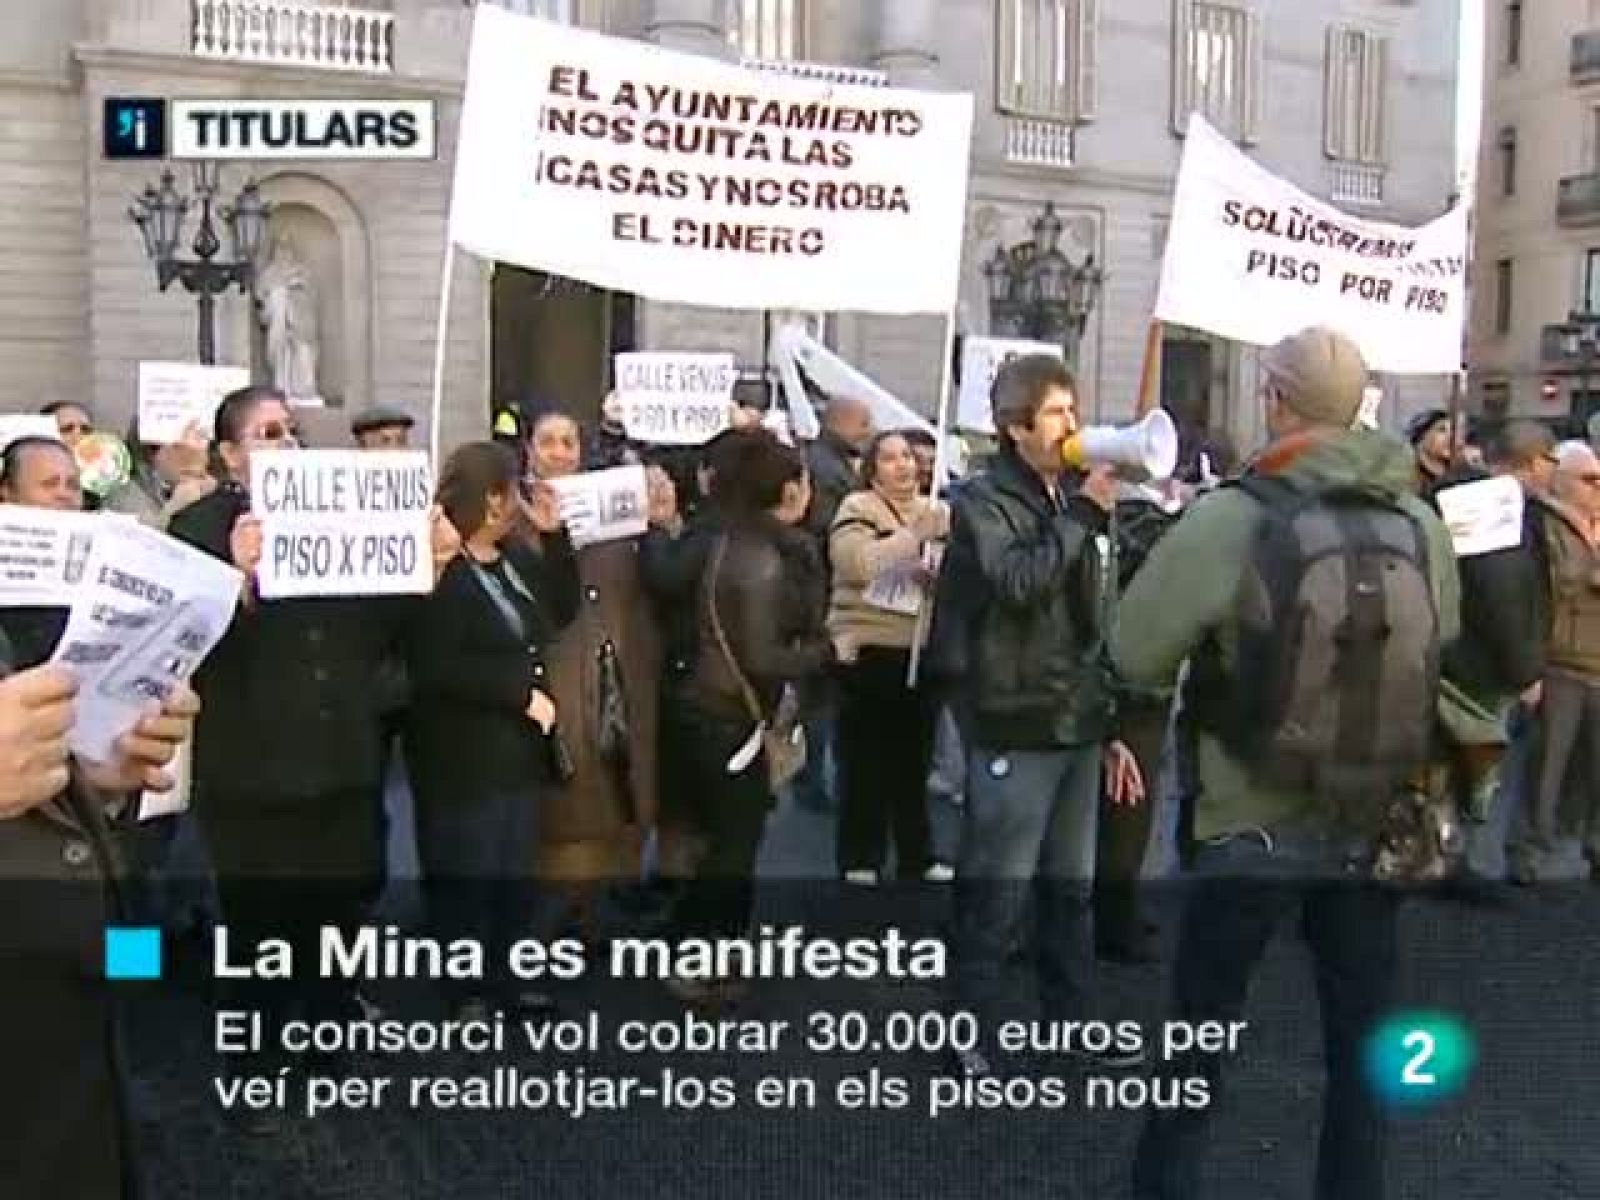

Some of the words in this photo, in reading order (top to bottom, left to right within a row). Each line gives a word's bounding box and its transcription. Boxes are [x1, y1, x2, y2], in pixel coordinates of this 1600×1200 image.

[548, 65, 600, 101] EL
[611, 80, 924, 137] AYUNTAMIENTO
[547, 107, 636, 145] NOS
[643, 119, 771, 162] QUITA
[781, 136, 853, 169] LAS
[547, 154, 689, 199] CASAS
[697, 172, 720, 201] Y
[725, 175, 811, 208] NOS
[814, 180, 911, 214] ROBA
[612, 212, 664, 244] EL
[672, 217, 825, 257] DINERO
[1247, 250, 1321, 285] PISO
[1340, 272, 1393, 304] POR
[263, 466, 346, 512] CALLE
[354, 466, 428, 512] VENUS
[273, 532, 332, 578] PISO
[339, 530, 356, 576] X
[362, 532, 417, 576] PISO
